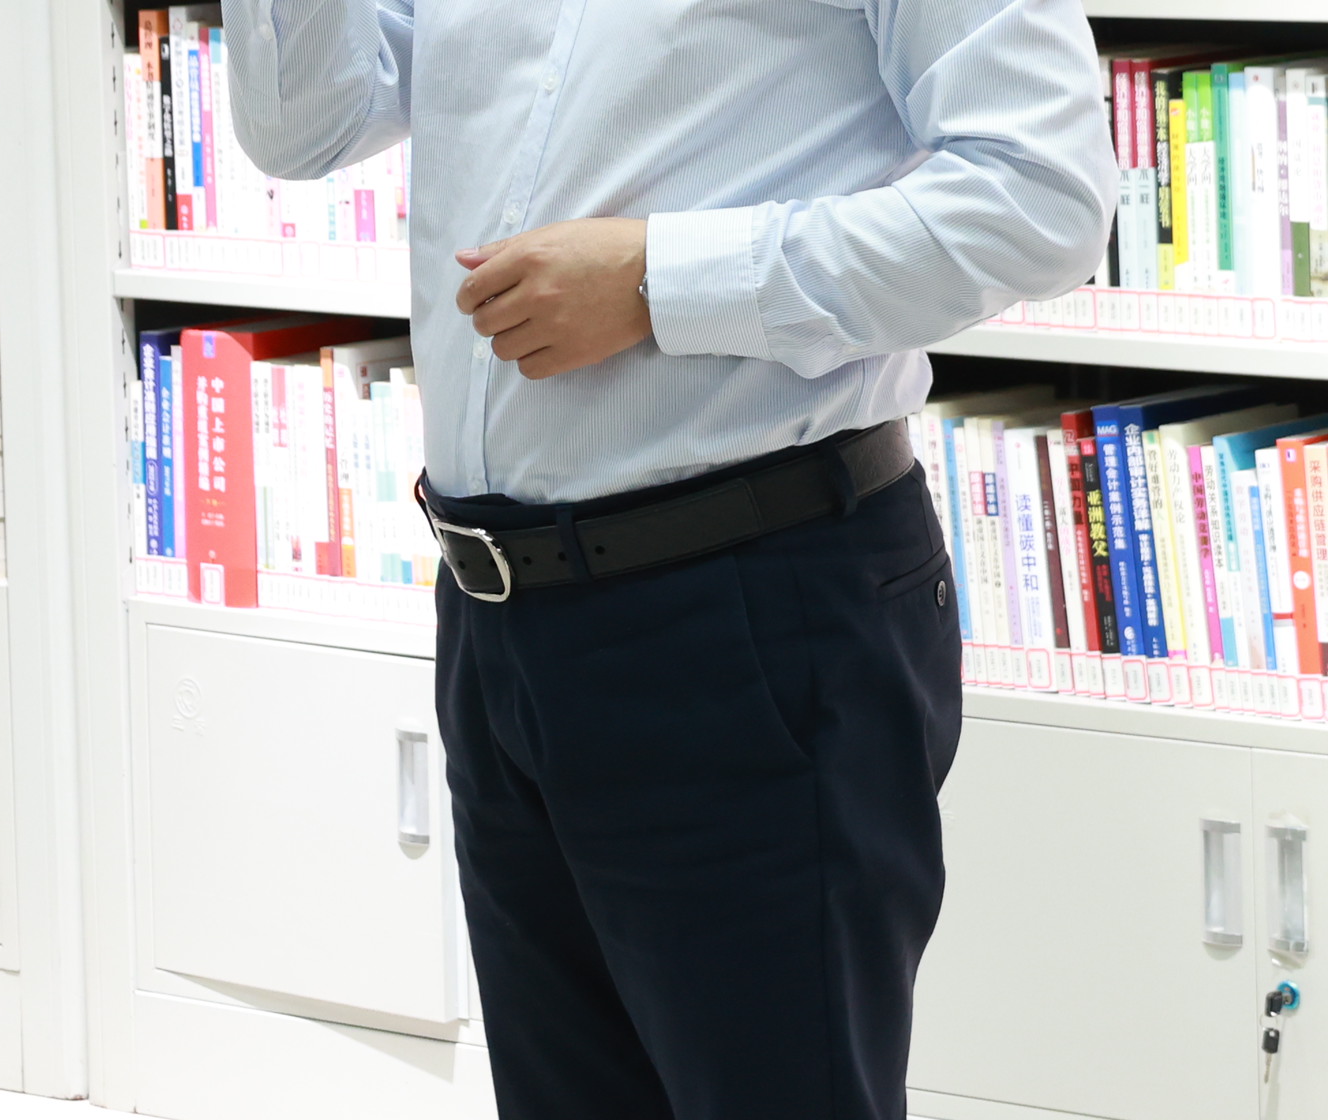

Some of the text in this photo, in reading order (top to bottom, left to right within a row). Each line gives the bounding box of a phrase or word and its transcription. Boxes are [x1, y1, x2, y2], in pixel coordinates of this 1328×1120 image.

[211, 376, 226, 493] 中国上市公司
[1123, 423, 1151, 532] 企业内部审计实务详解
[1014, 494, 1040, 593] 读懂碳中和
[1087, 489, 1110, 559] 亚洲教父
[1102, 443, 1128, 550] 管理会计案例示范集
[1204, 464, 1224, 570] 劳动关系知识读本
[1309, 459, 1328, 562] 采购供应链管理
